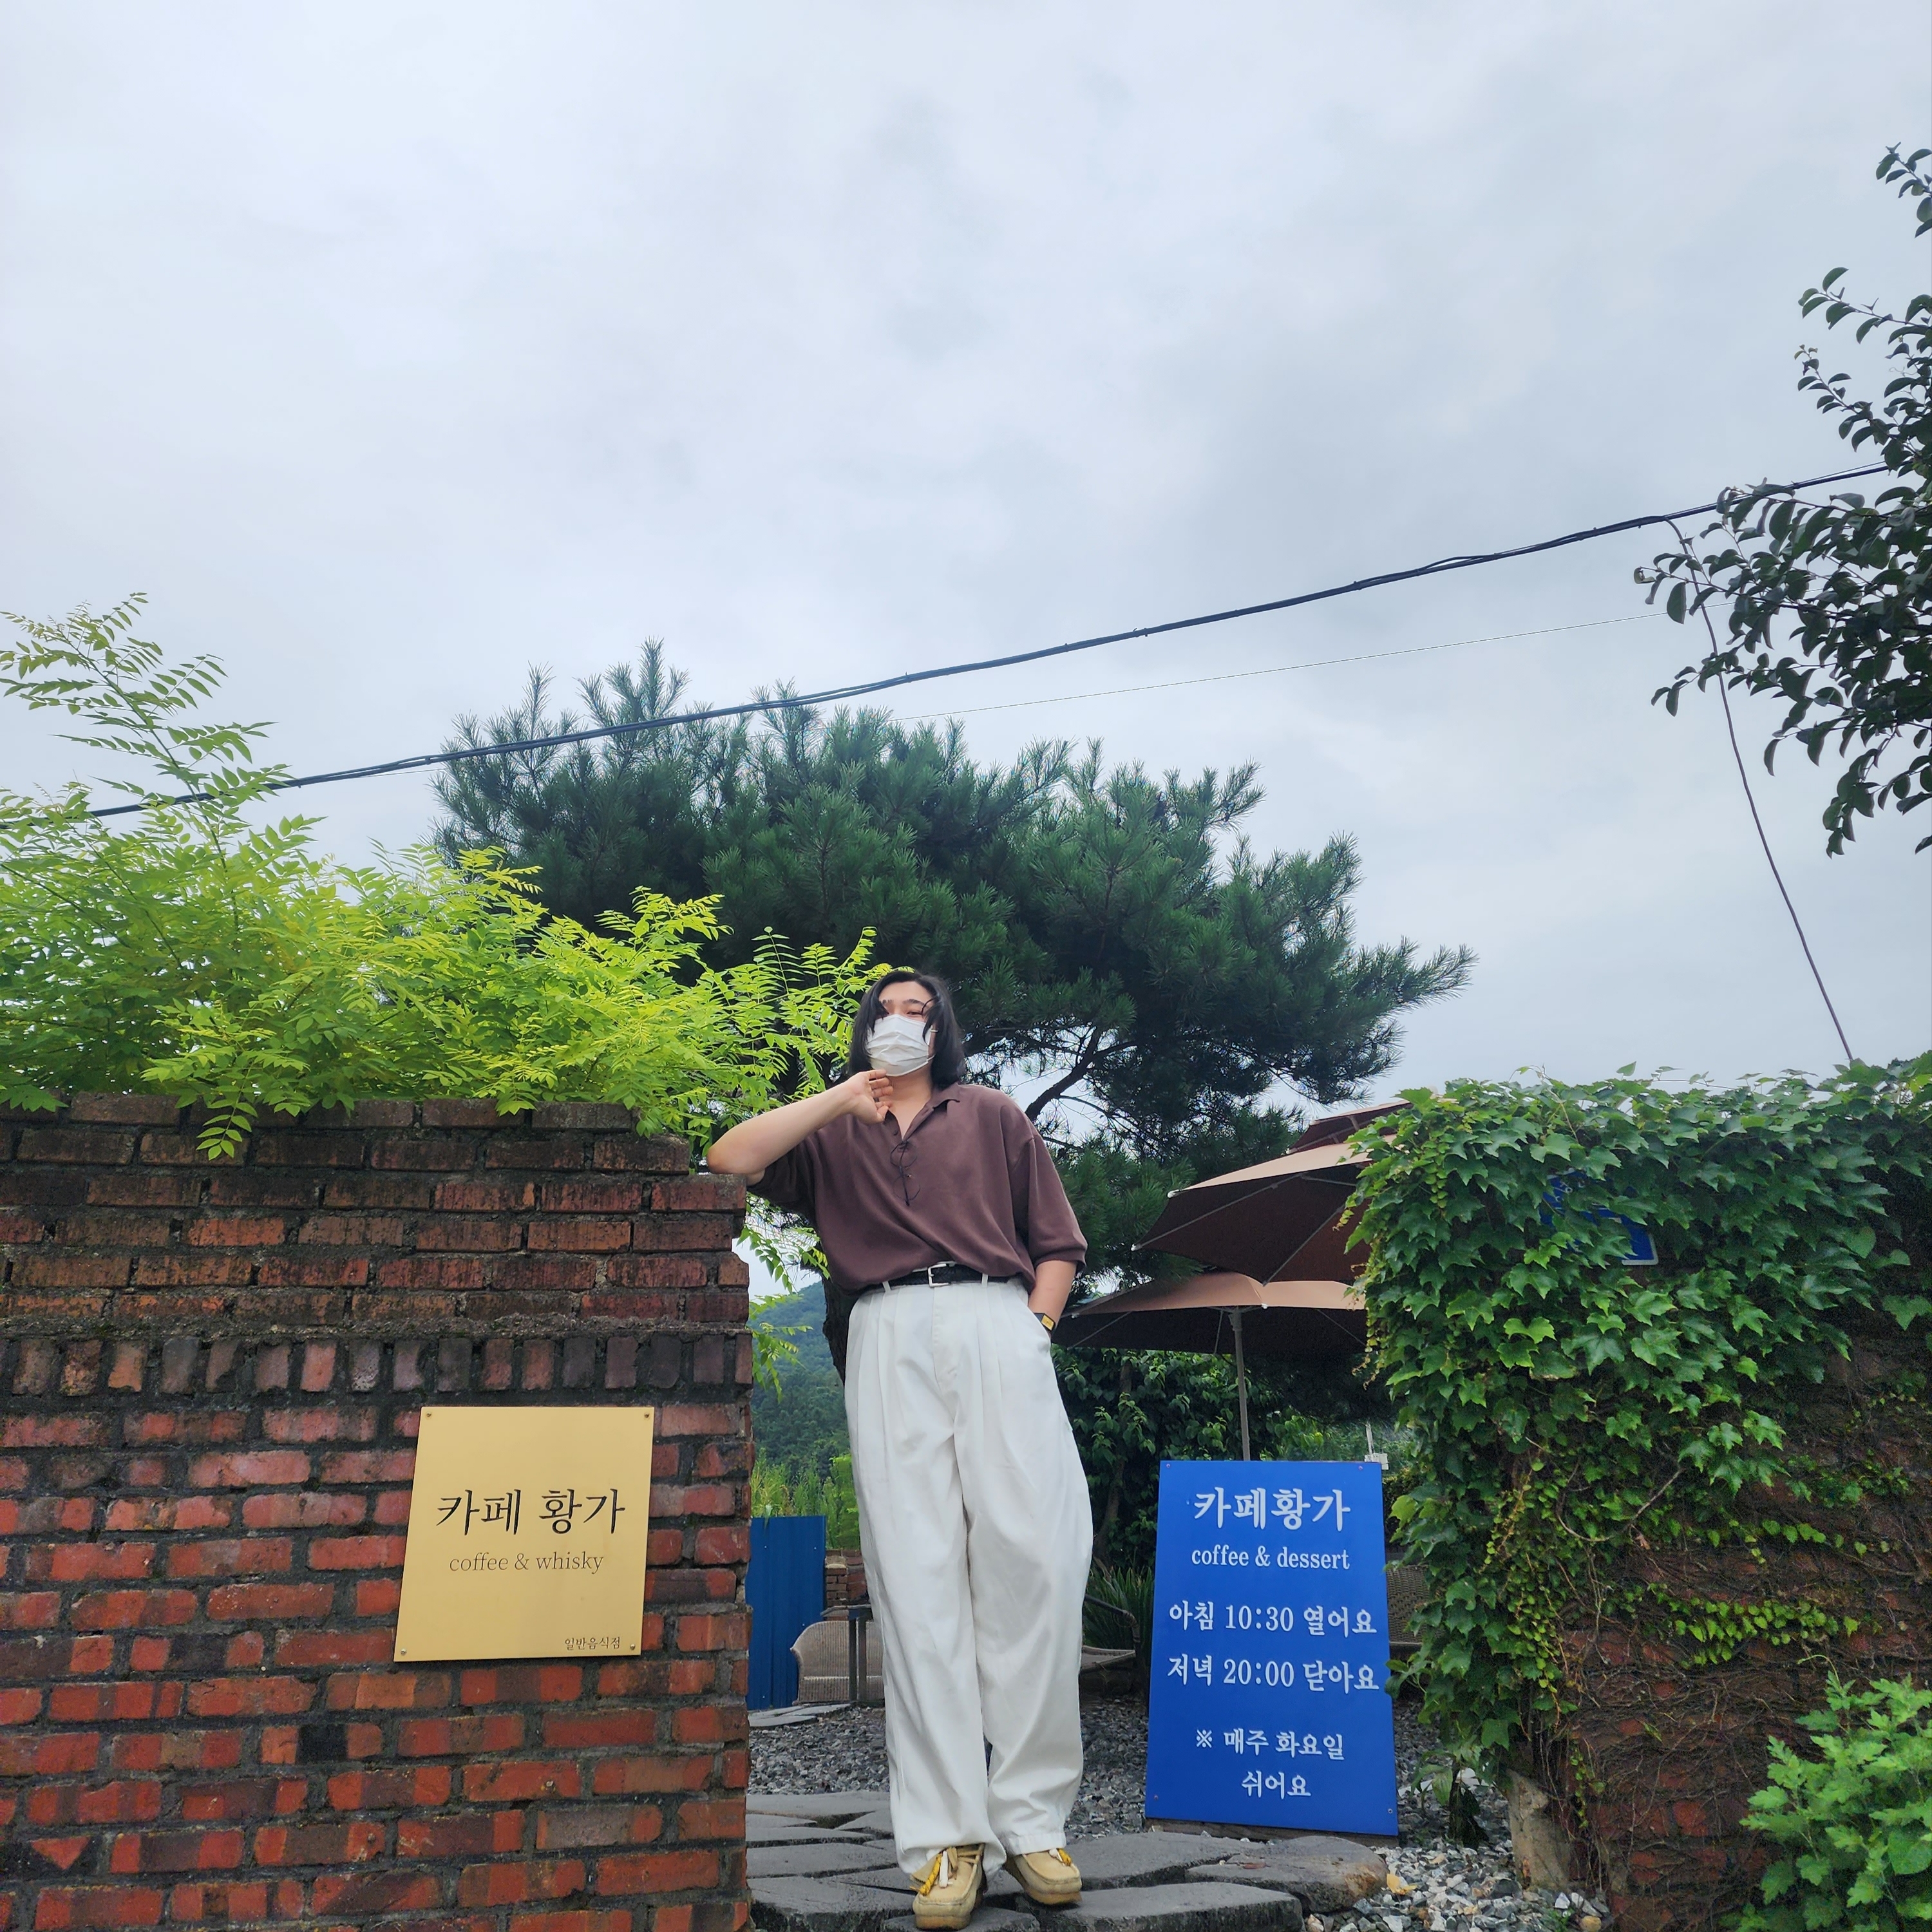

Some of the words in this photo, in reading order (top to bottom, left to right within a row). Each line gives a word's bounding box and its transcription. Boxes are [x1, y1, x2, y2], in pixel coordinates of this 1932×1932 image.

[435, 1488, 521, 1536] 카페
[538, 1488, 626, 1535] 황가
[1194, 1486, 1351, 1531] 카페황가
[450, 1551, 509, 1572] coffee
[514, 1553, 530, 1571] &
[535, 1551, 604, 1575] whisky
[1191, 1544, 1249, 1566] coffee
[1255, 1545, 1271, 1567] &
[1276, 1546, 1350, 1570] dessert
[1169, 1600, 1214, 1631] 아침
[1226, 1604, 1294, 1632] 10:30
[1303, 1605, 1378, 1638] 열어요
[564, 1636, 620, 1651] 일반음식점
[1167, 1653, 1212, 1687] 저녁
[1223, 1658, 1294, 1687] 20:00
[1302, 1660, 1379, 1694] 닫아요
[1223, 1727, 1269, 1756] 매주
[1275, 1730, 1345, 1760] 화요일
[1241, 1770, 1311, 1799] 쉬어요
